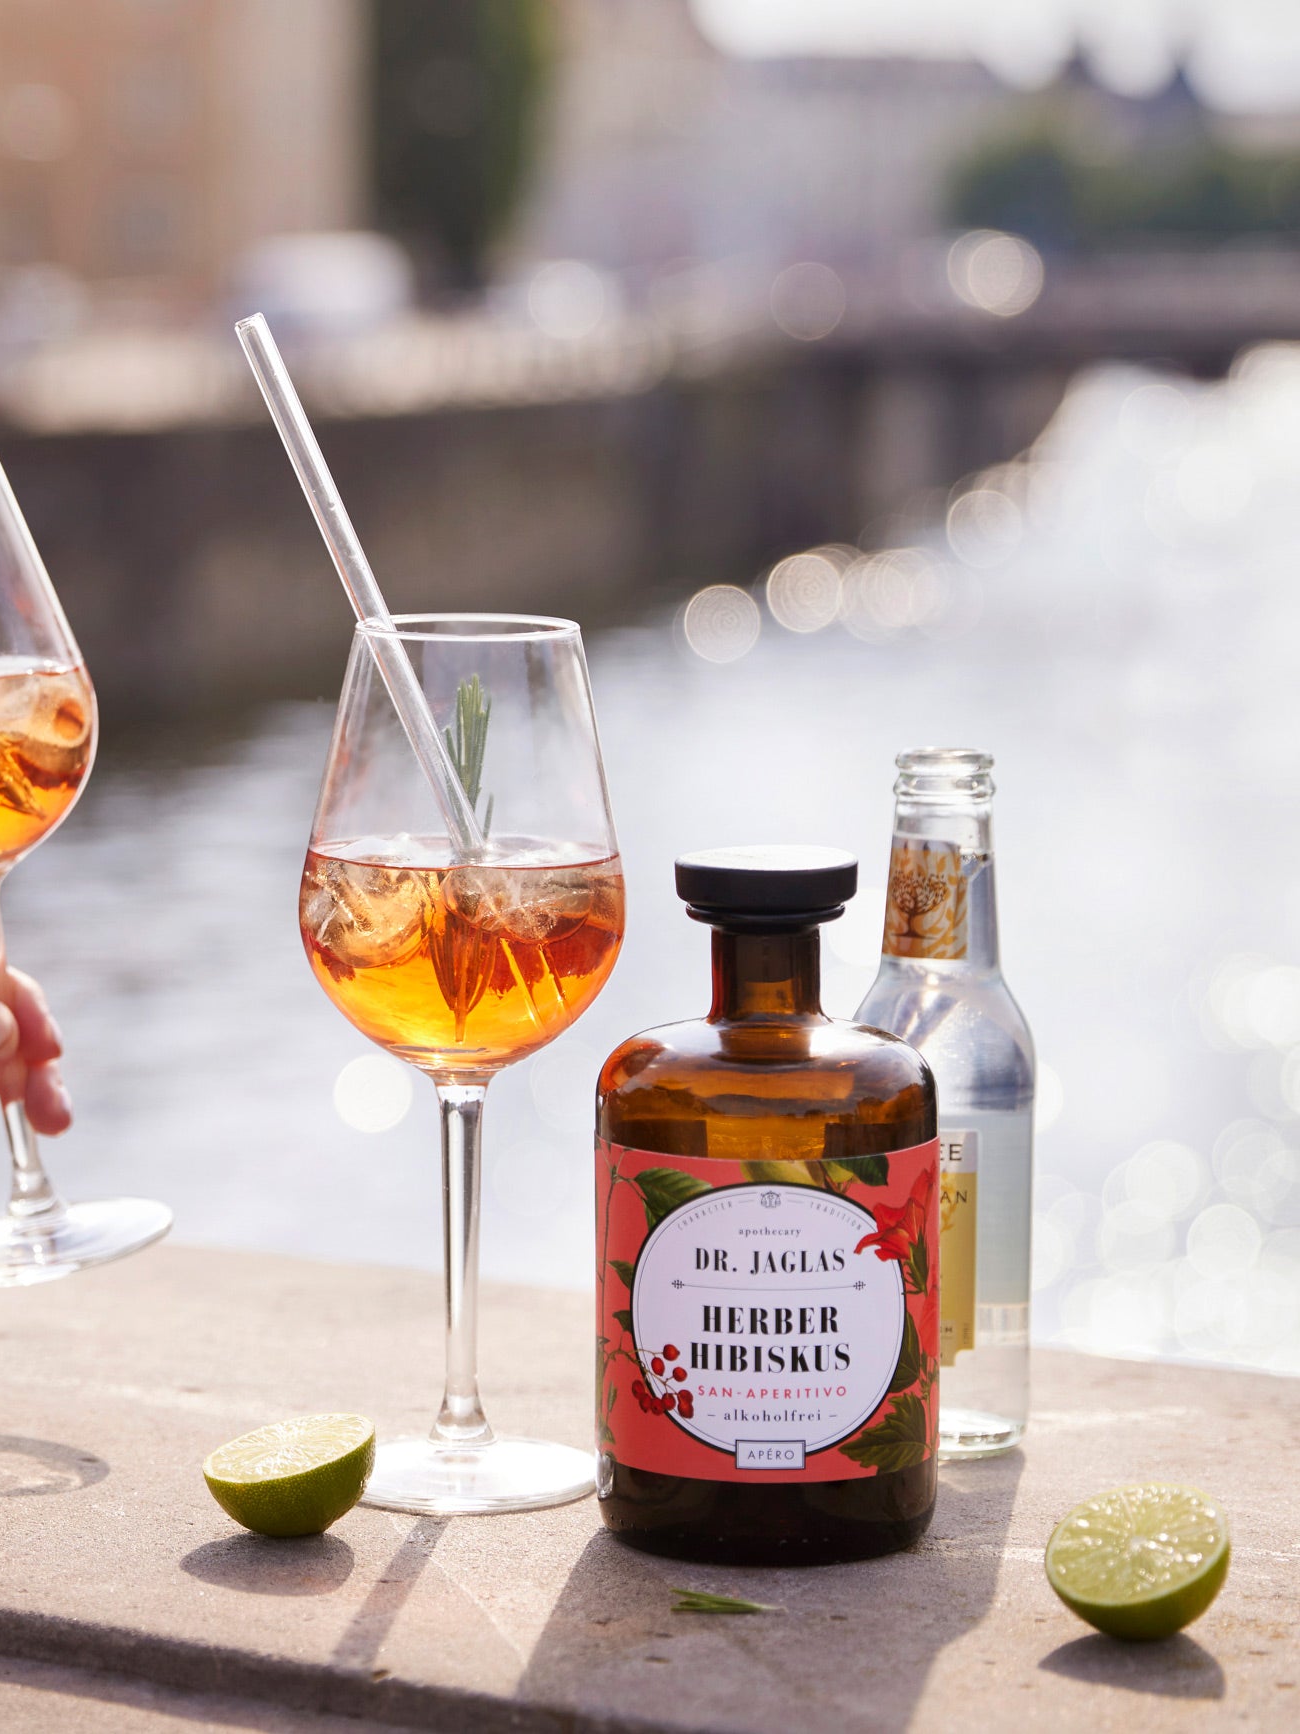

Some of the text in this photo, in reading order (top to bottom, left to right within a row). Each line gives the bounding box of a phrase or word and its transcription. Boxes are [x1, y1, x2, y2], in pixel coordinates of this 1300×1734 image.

[677, 1201, 863, 1231] CHARACTER TRADITION
[738, 1227, 801, 1237] apothecary
[695, 1247, 846, 1275] DR. JAGLAS
[702, 1304, 839, 1335] HERBER
[690, 1341, 850, 1374] HIBISKUS
[698, 1385, 847, 1399] SAN-APERITIVO
[723, 1408, 822, 1422] alkoholfrei
[747, 1448, 795, 1460] APÉRO
